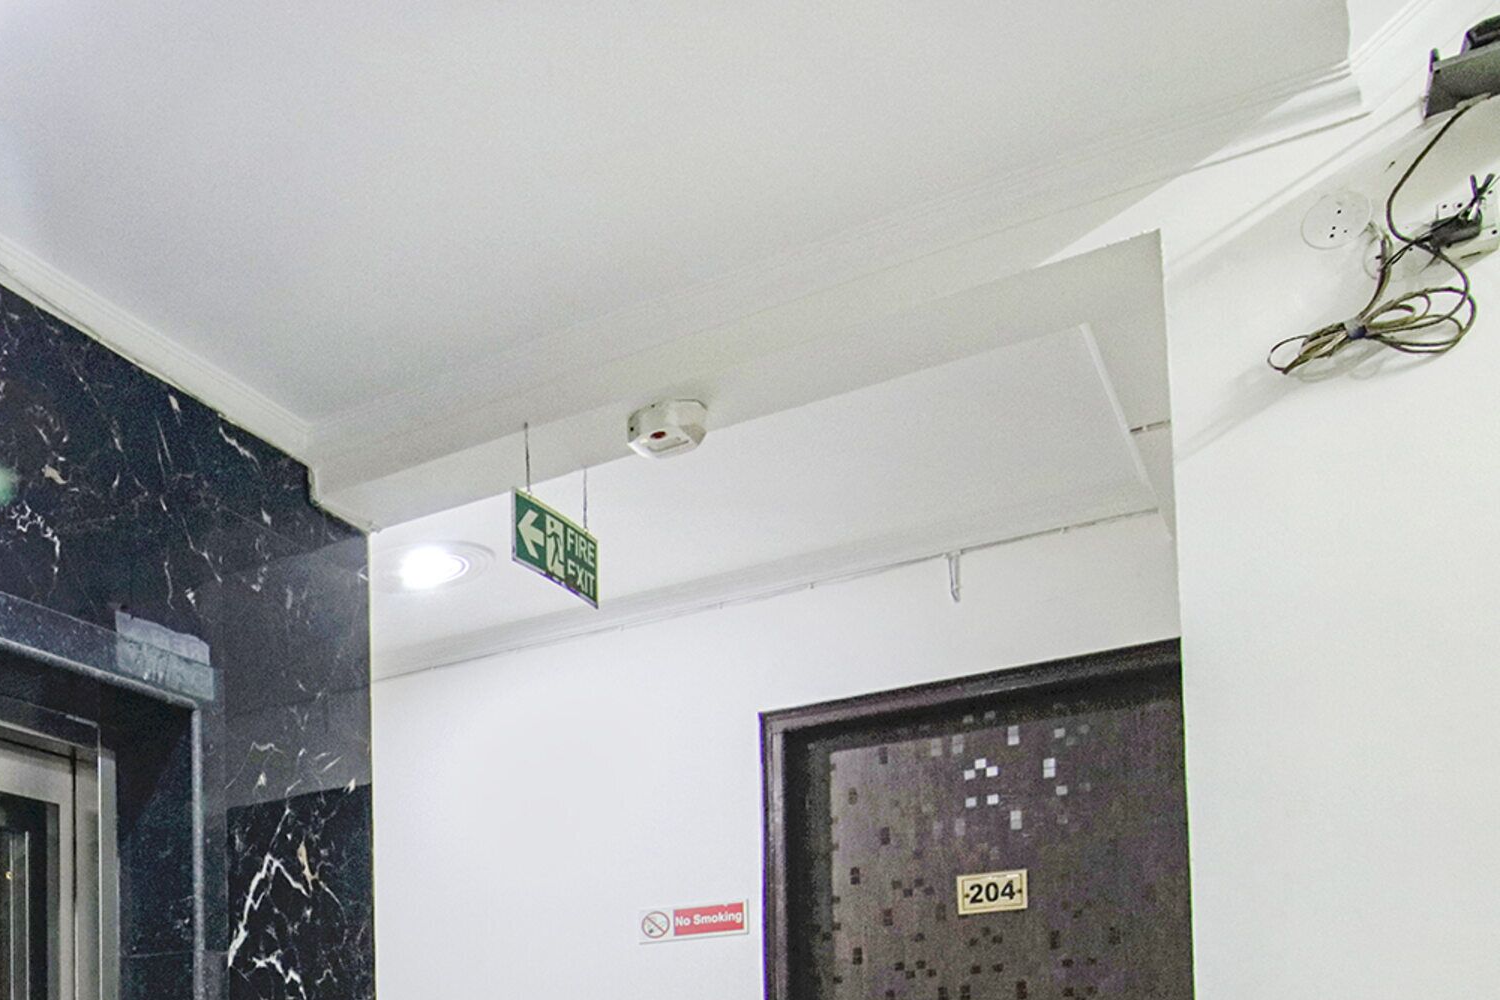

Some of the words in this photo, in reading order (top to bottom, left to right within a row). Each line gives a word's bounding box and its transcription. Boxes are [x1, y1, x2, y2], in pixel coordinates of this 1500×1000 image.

[566, 526, 596, 569] FIRE
[566, 558, 596, 597] EXIT
[969, 879, 1016, 904] 204
[674, 915, 692, 928] No
[692, 910, 744, 925] Smoking
